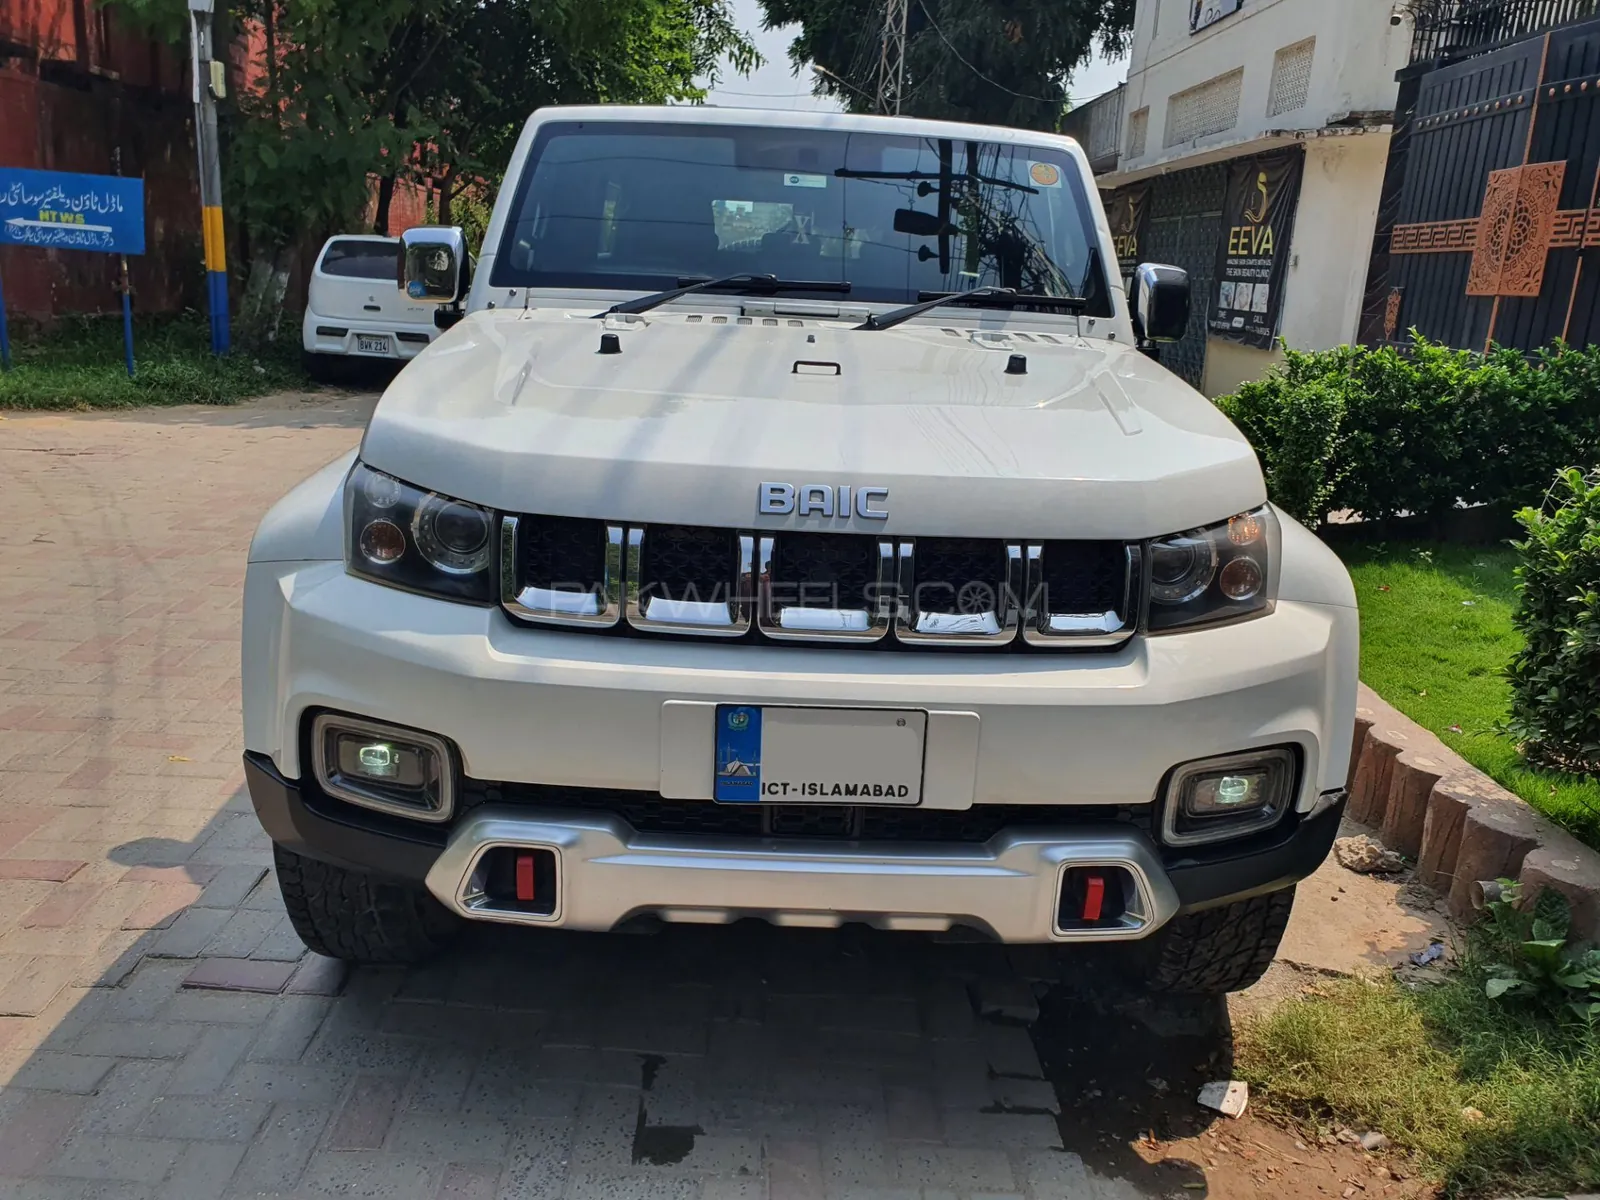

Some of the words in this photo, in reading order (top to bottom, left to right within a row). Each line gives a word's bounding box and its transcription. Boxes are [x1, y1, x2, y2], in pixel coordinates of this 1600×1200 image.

[1228, 225, 1273, 255] EEVA
[374, 341, 387, 351] 214
[759, 481, 889, 519] BAIC
[761, 782, 909, 798] ICT-ISLAMABAD
